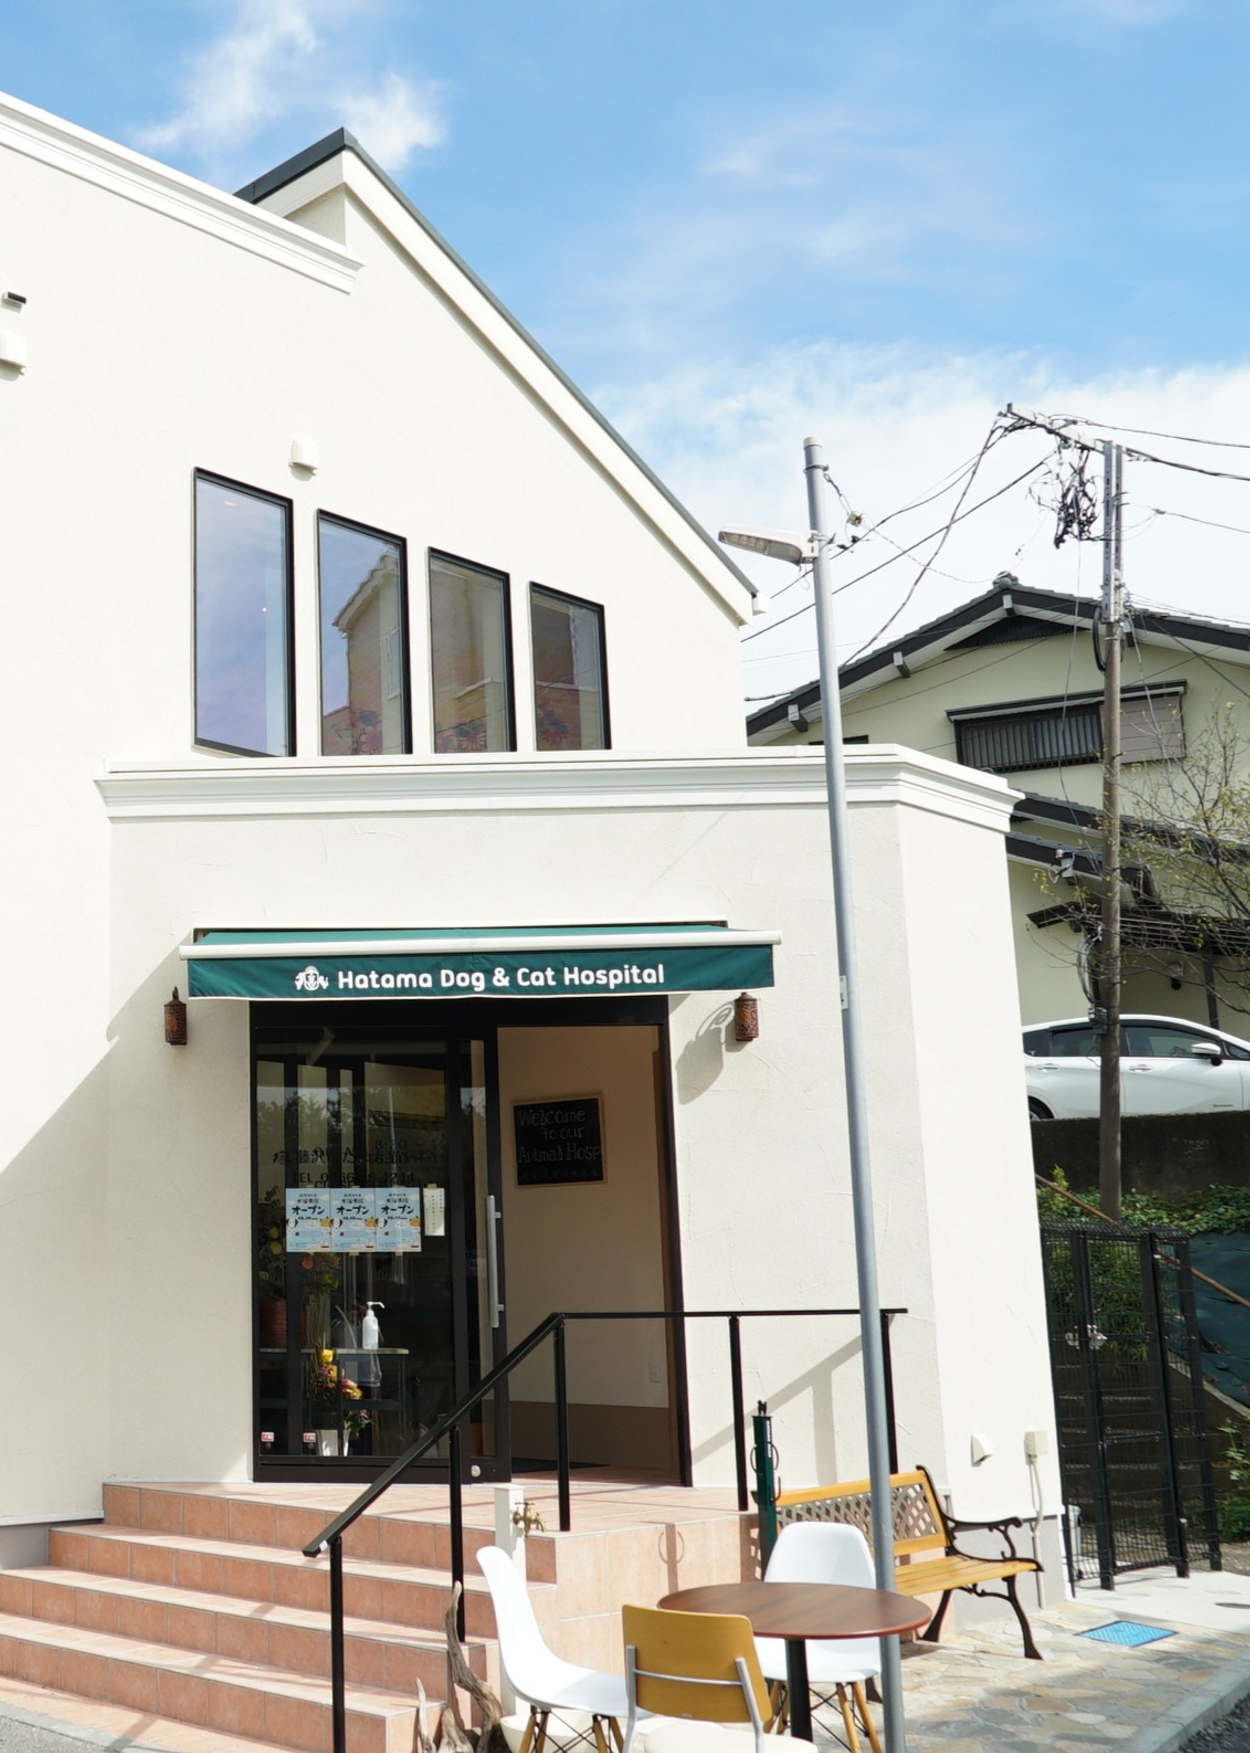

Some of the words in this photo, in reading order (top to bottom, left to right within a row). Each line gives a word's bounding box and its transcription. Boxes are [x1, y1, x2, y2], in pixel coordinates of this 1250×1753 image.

[338, 970, 432, 989] Hatama
[440, 969, 486, 992] Dog
[492, 966, 510, 987] &
[517, 966, 557, 986] Cat
[563, 964, 664, 990] Hospital
[517, 1108, 587, 1127] Welcome
[559, 1126, 584, 1139] our
[519, 1144, 563, 1163] Animal
[291, 1205, 325, 1215] オープン
[336, 1205, 369, 1215] オープン
[381, 1204, 414, 1215] オープン
